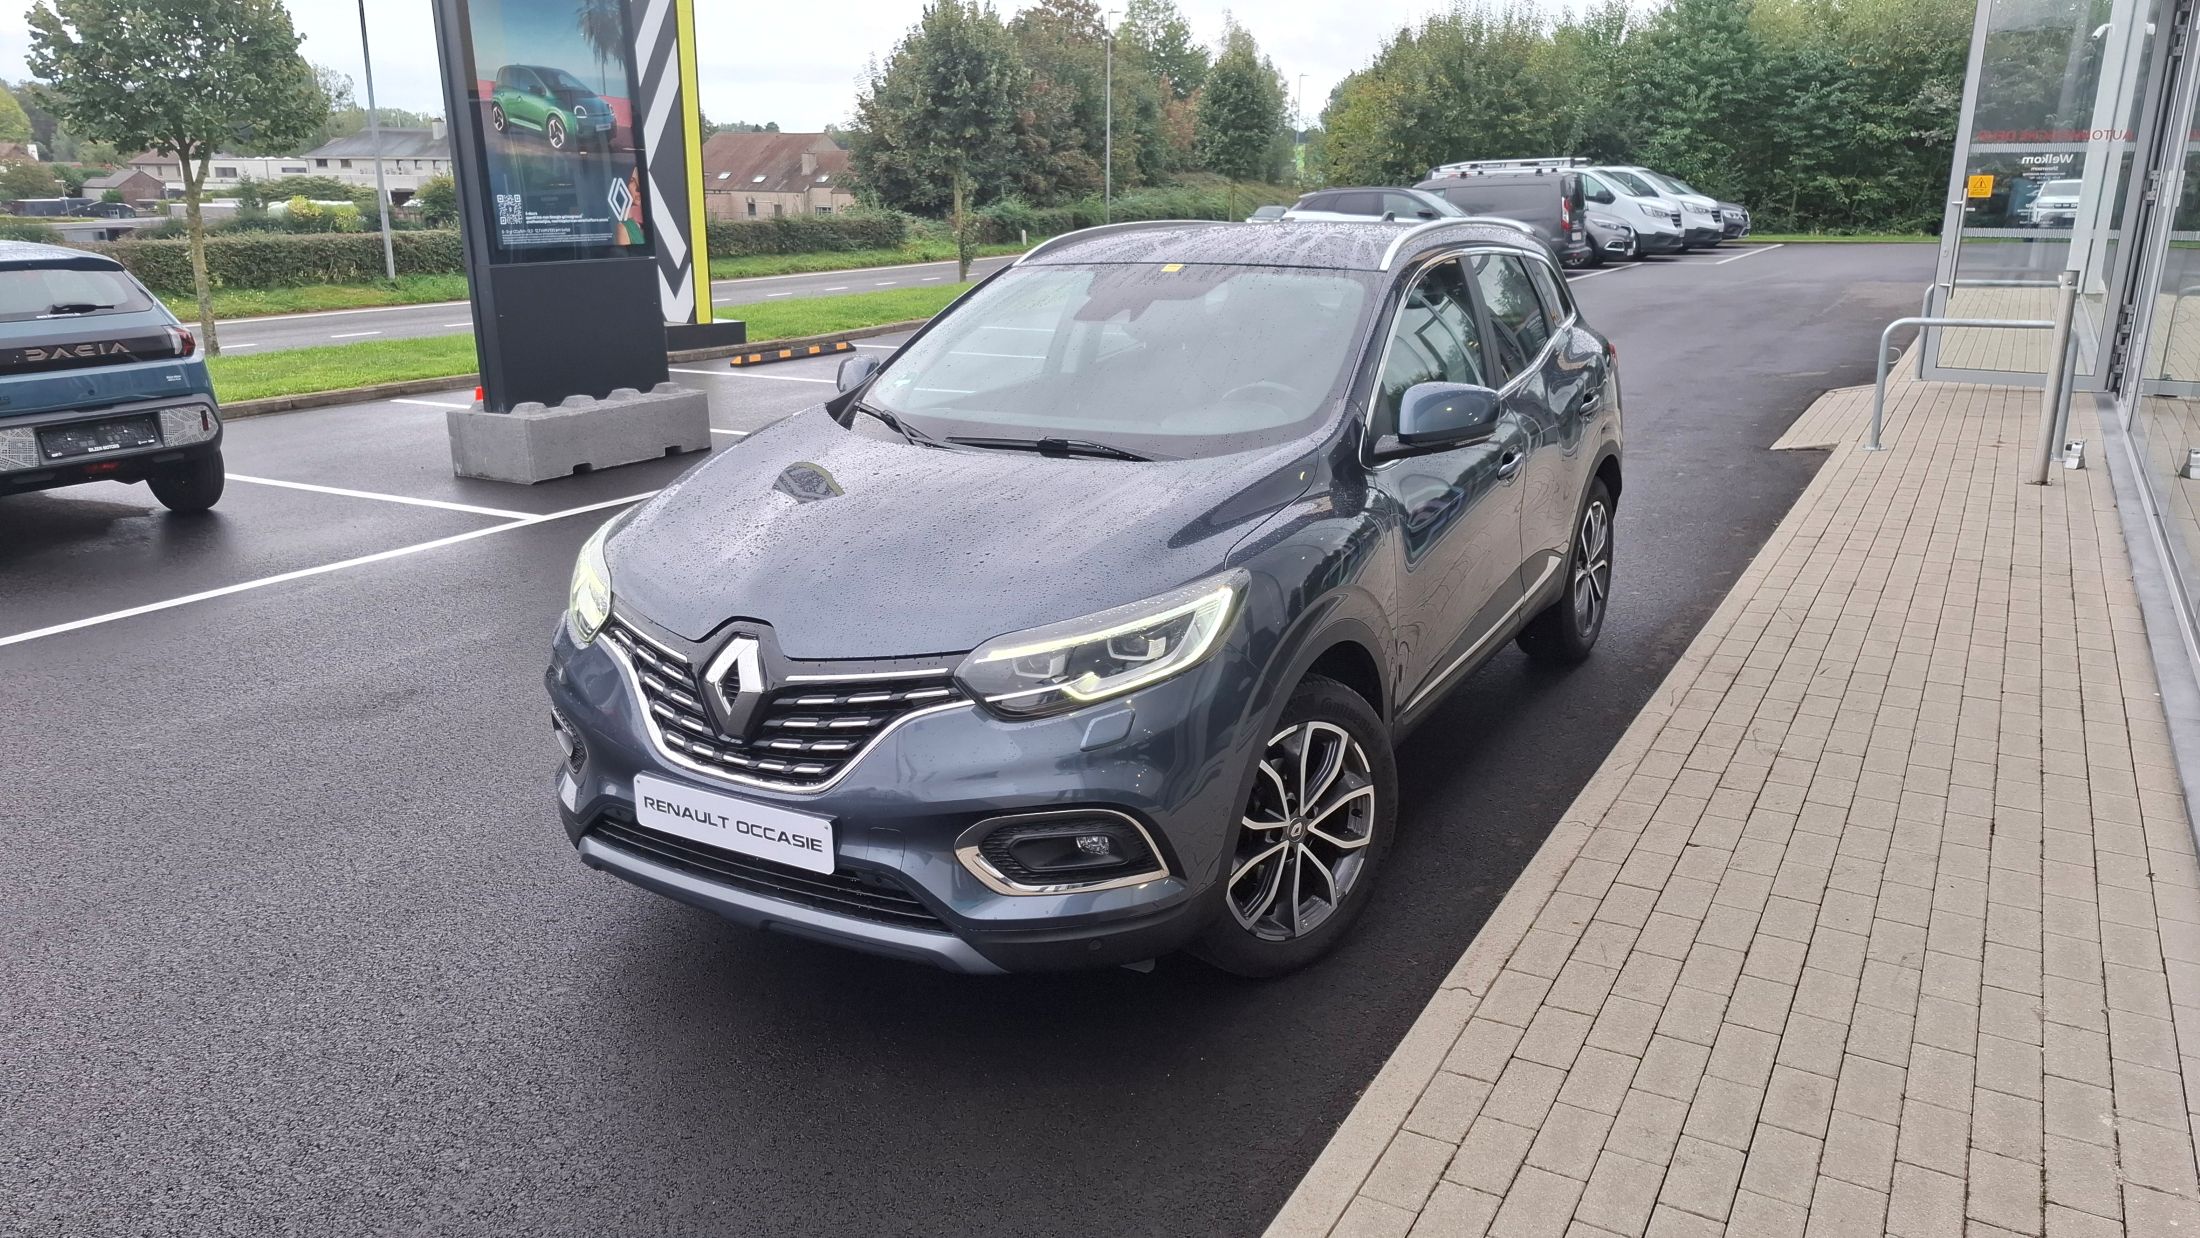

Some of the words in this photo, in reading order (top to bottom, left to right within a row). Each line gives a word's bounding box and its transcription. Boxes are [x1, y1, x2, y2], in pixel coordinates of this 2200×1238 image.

[24, 342, 130, 362] DACIA
[643, 795, 730, 829] RENAULT
[736, 820, 824, 852] OCCASIE
